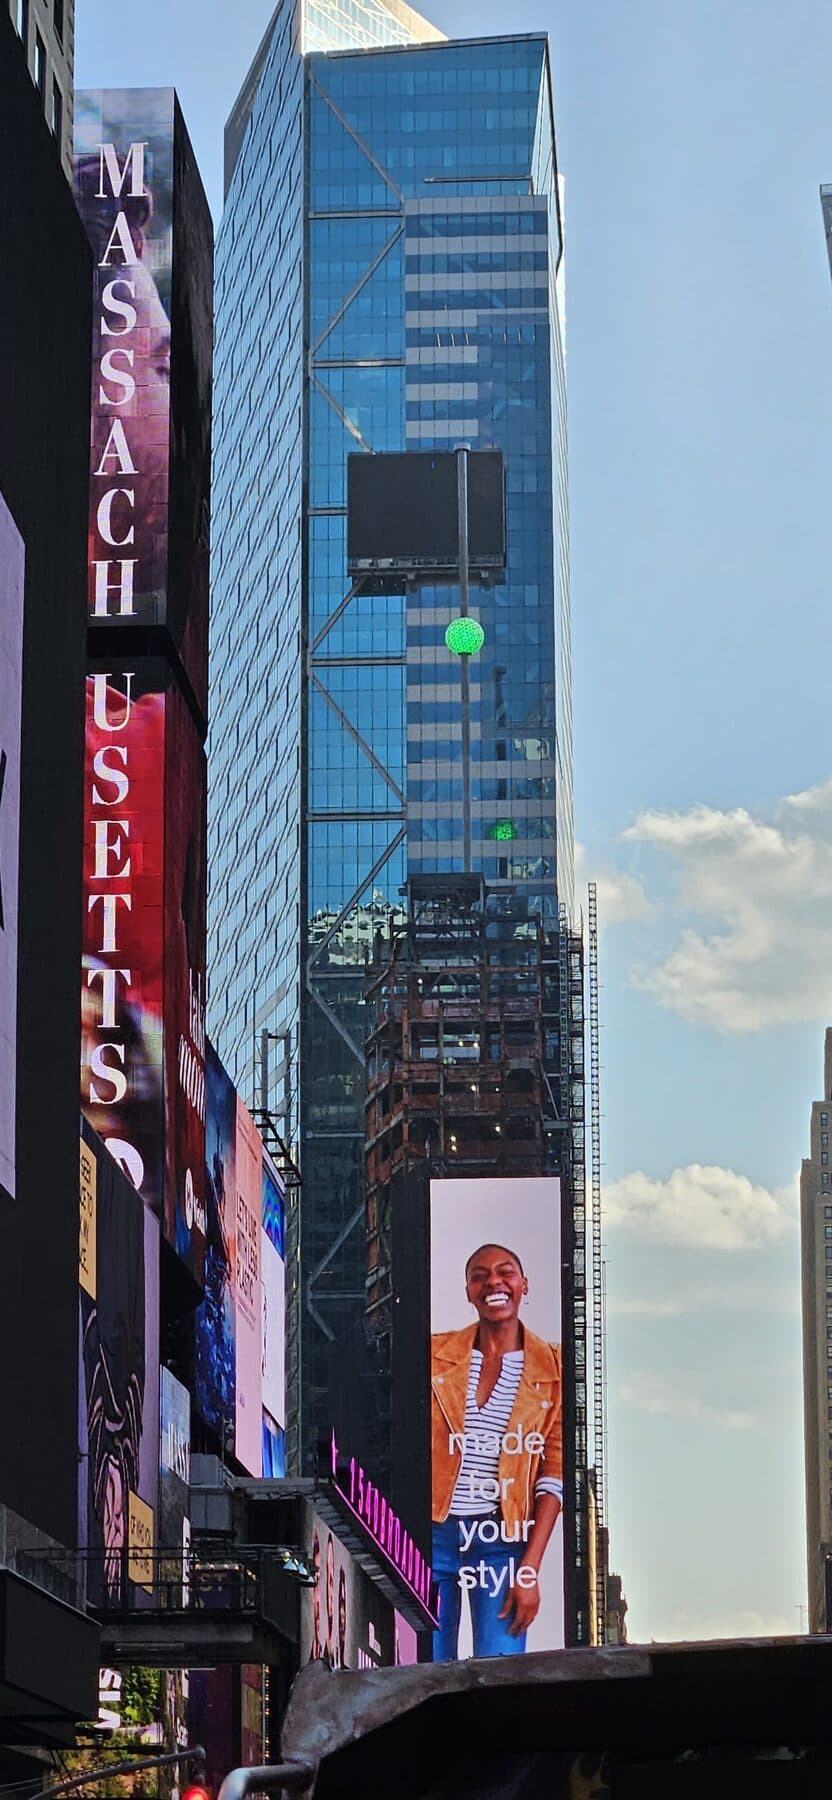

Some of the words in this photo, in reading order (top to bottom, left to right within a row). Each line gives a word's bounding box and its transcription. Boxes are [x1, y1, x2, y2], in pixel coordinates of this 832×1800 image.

[448, 1424, 546, 1456] made
[469, 1468, 515, 1501] for
[458, 1519, 536, 1552] your
[457, 1556, 538, 1598] style
